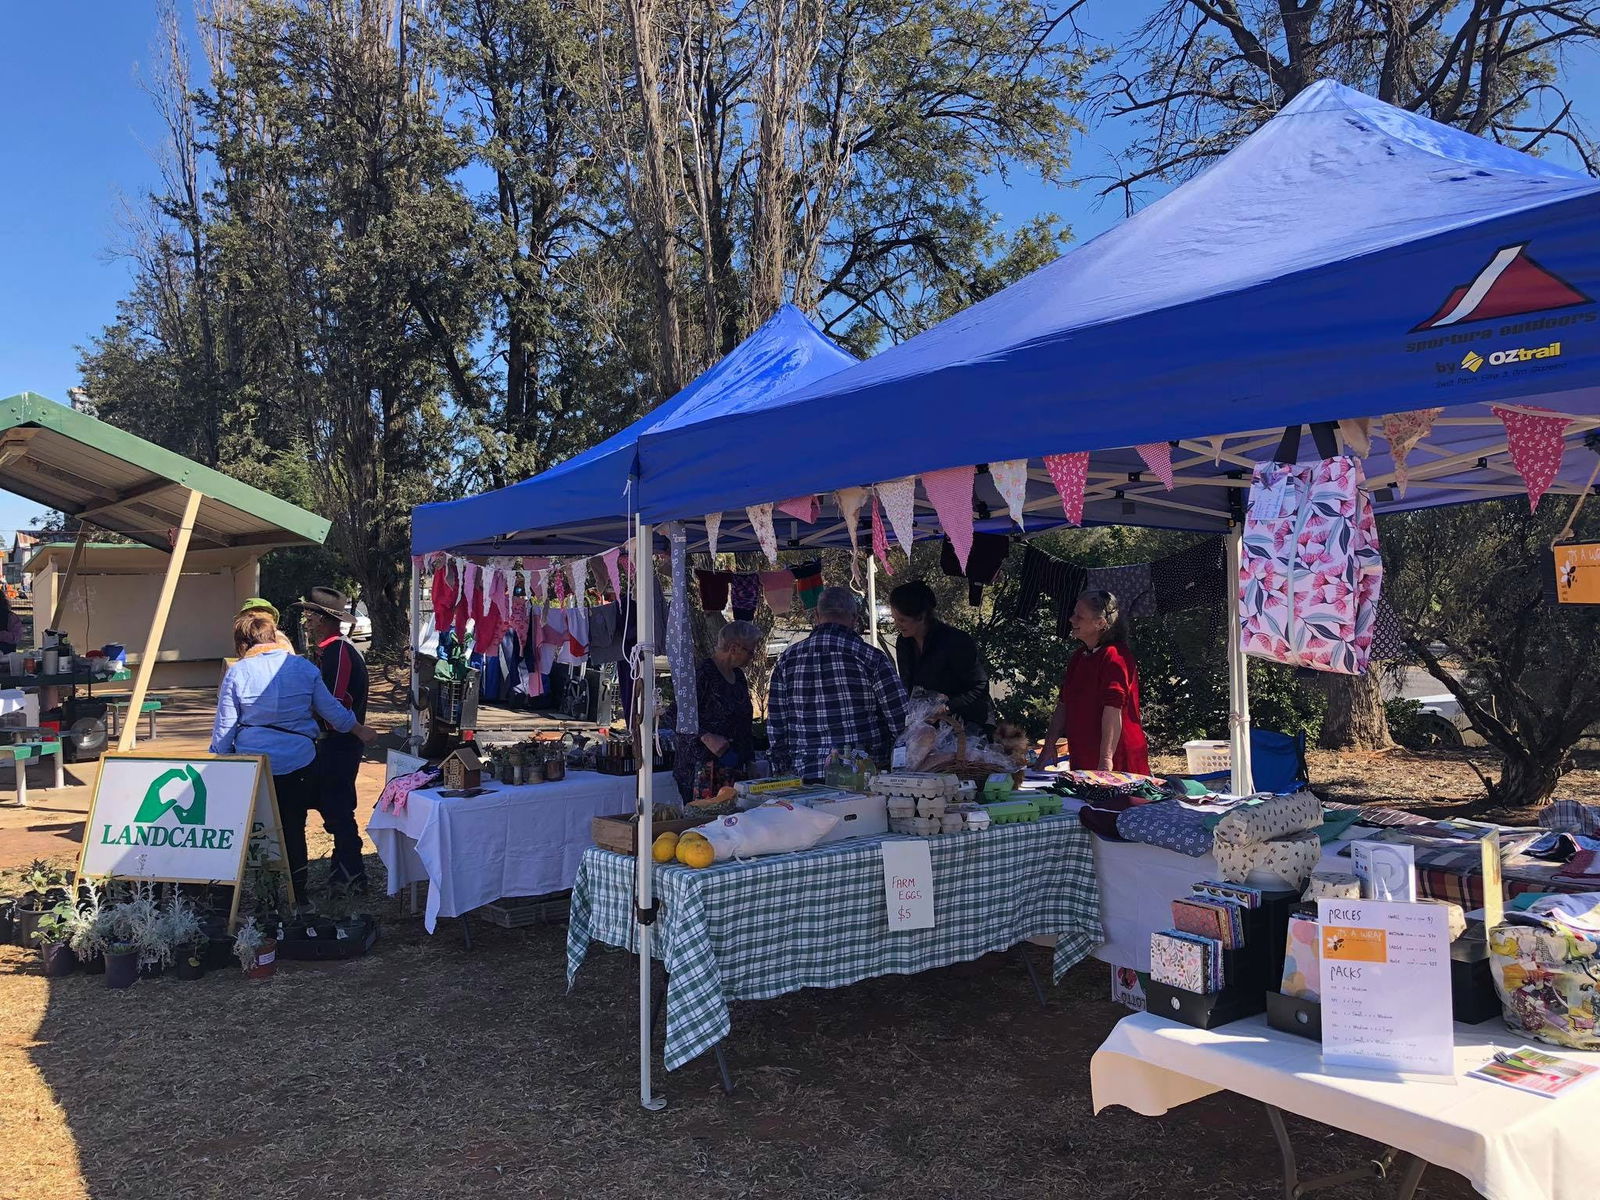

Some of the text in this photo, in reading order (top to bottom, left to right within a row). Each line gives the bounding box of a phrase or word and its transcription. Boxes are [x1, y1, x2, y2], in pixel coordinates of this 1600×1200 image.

[1488, 341, 1561, 365] OZtrail
[100, 824, 235, 849] LANDCARE
[892, 875, 916, 888] FARM
[898, 890, 922, 900] EGGS
[898, 905, 912, 921] $5
[1328, 908, 1361, 924] PRICES
[1330, 965, 1361, 981] PACKS
